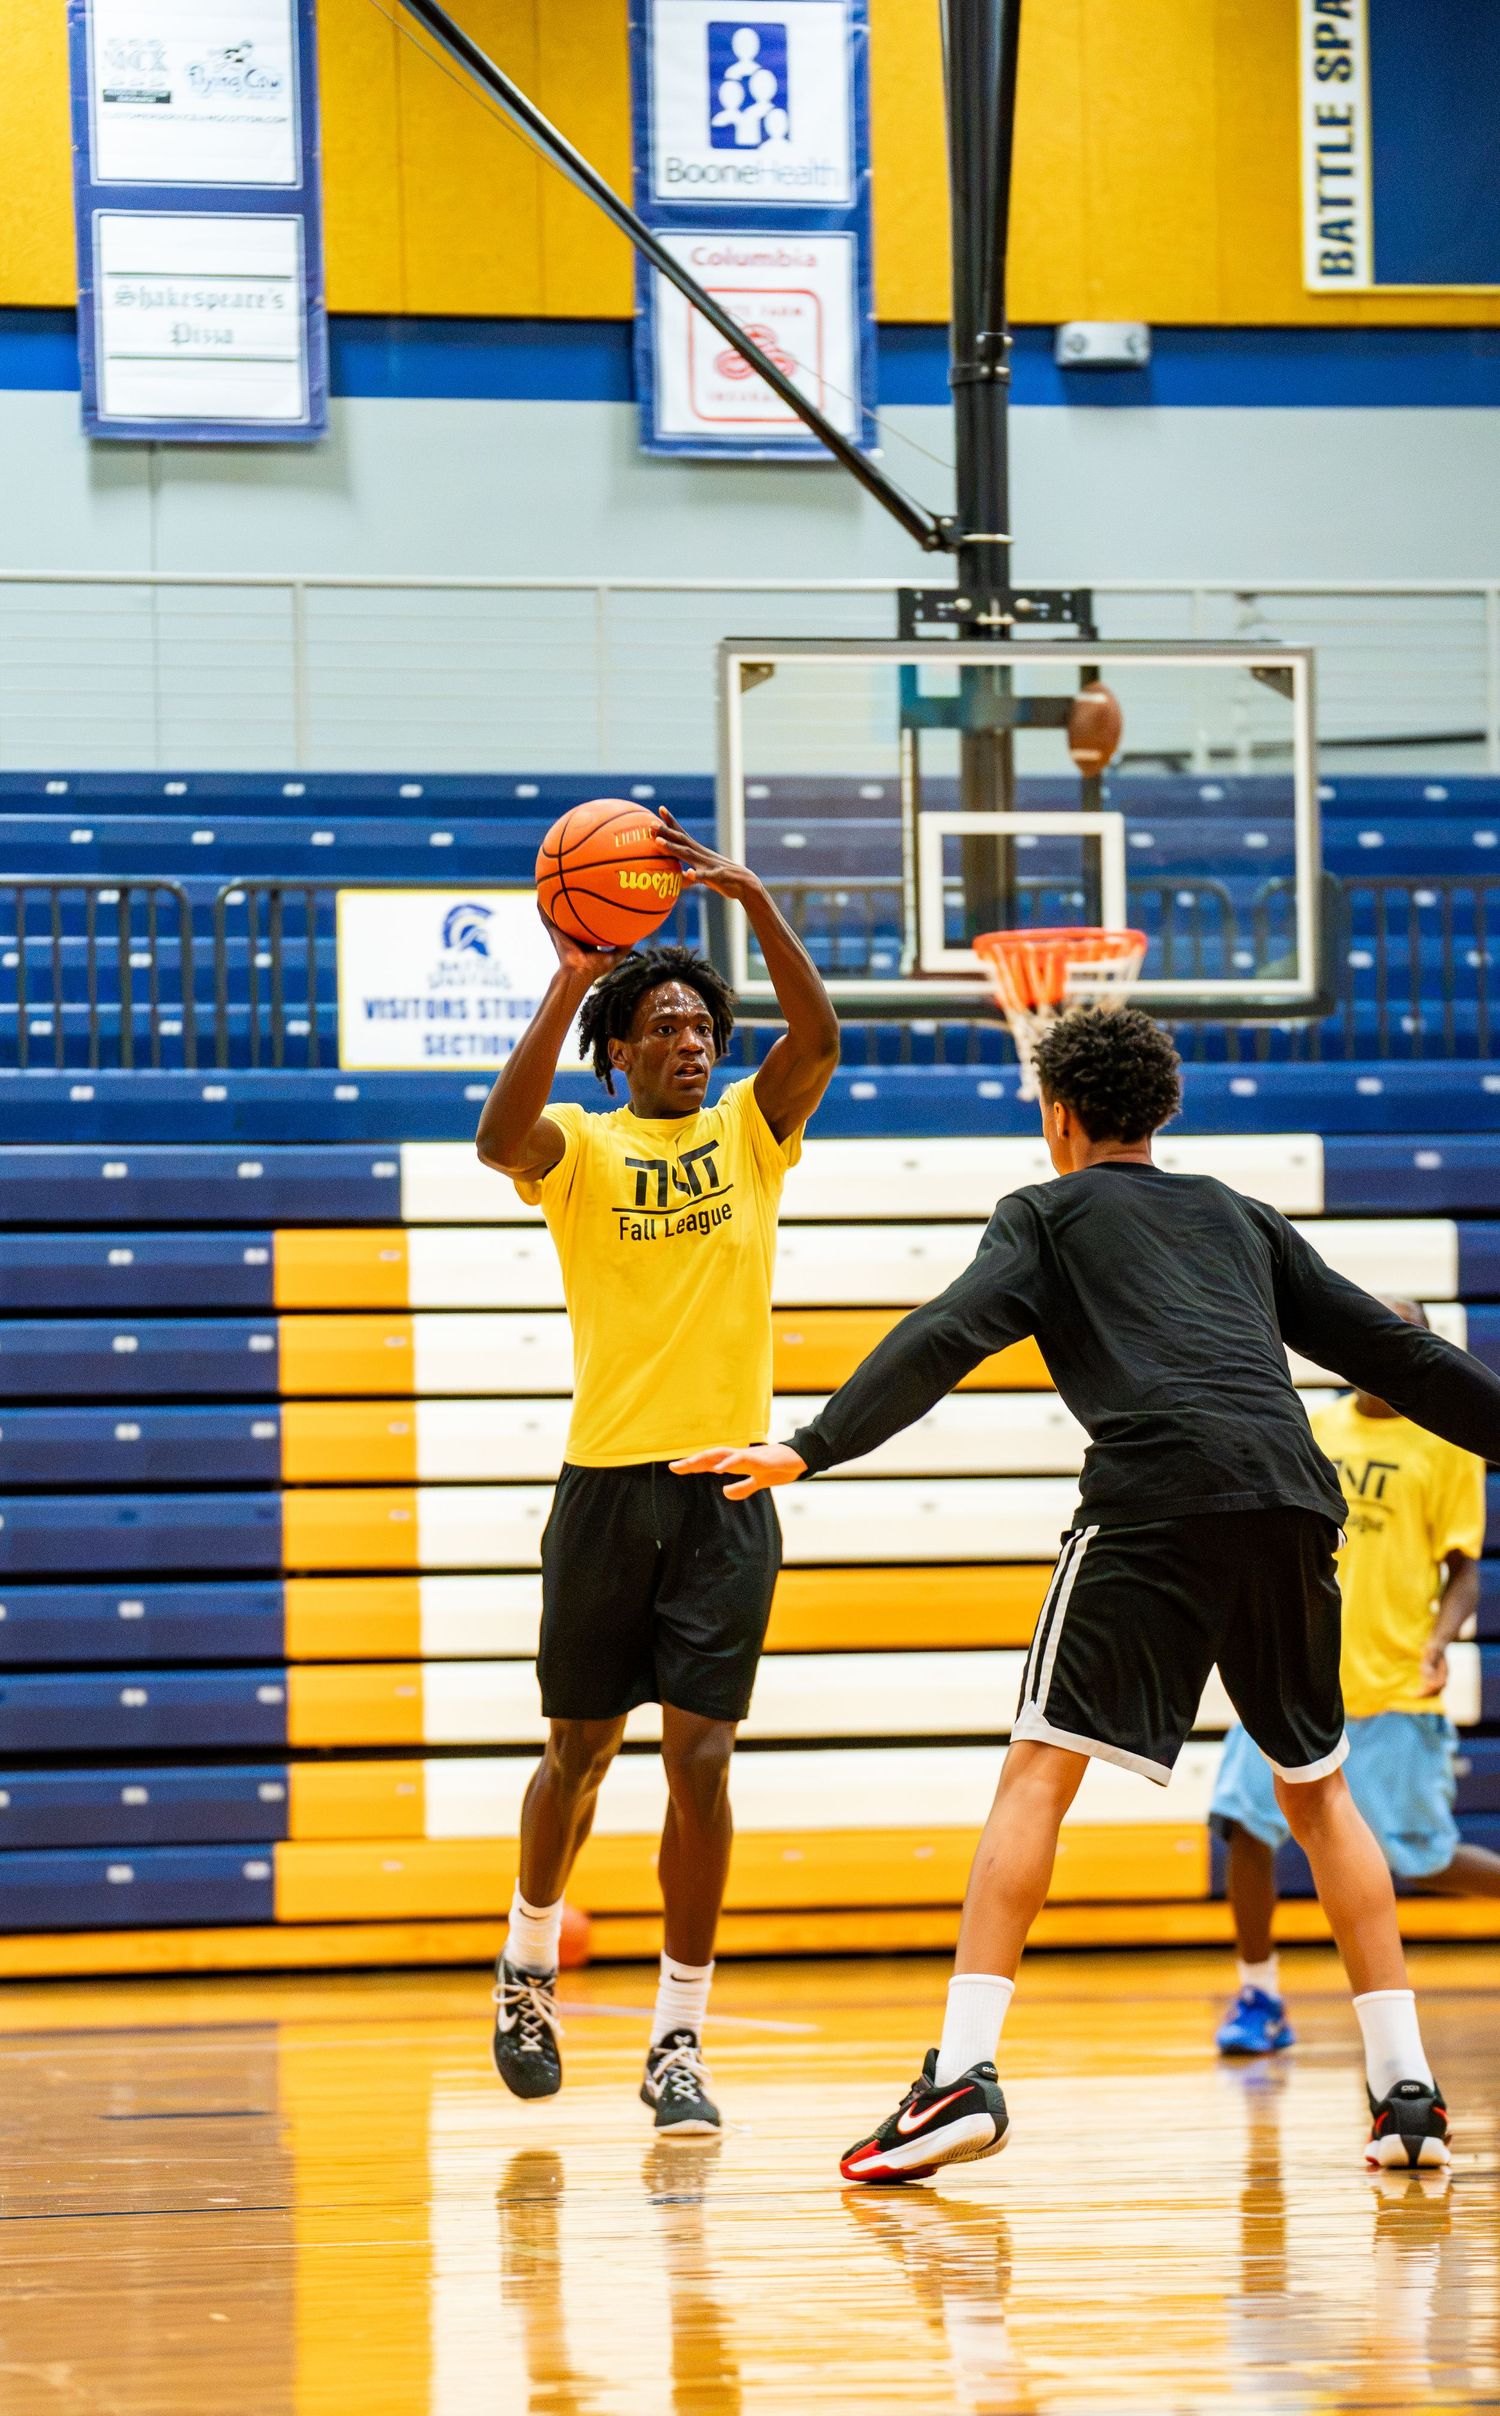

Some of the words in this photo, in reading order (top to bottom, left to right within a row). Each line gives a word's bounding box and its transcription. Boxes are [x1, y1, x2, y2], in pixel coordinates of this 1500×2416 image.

[1313, 0, 1353, 82] SPA
[1315, 104, 1355, 277] BATTLE
[690, 246, 817, 268] Columbia
[113, 284, 286, 311] Shakespeare's
[363, 997, 467, 1020] VISITORS
[477, 997, 543, 1020] STUD
[619, 1216, 656, 1241] Fall
[664, 1203, 732, 1237] League
